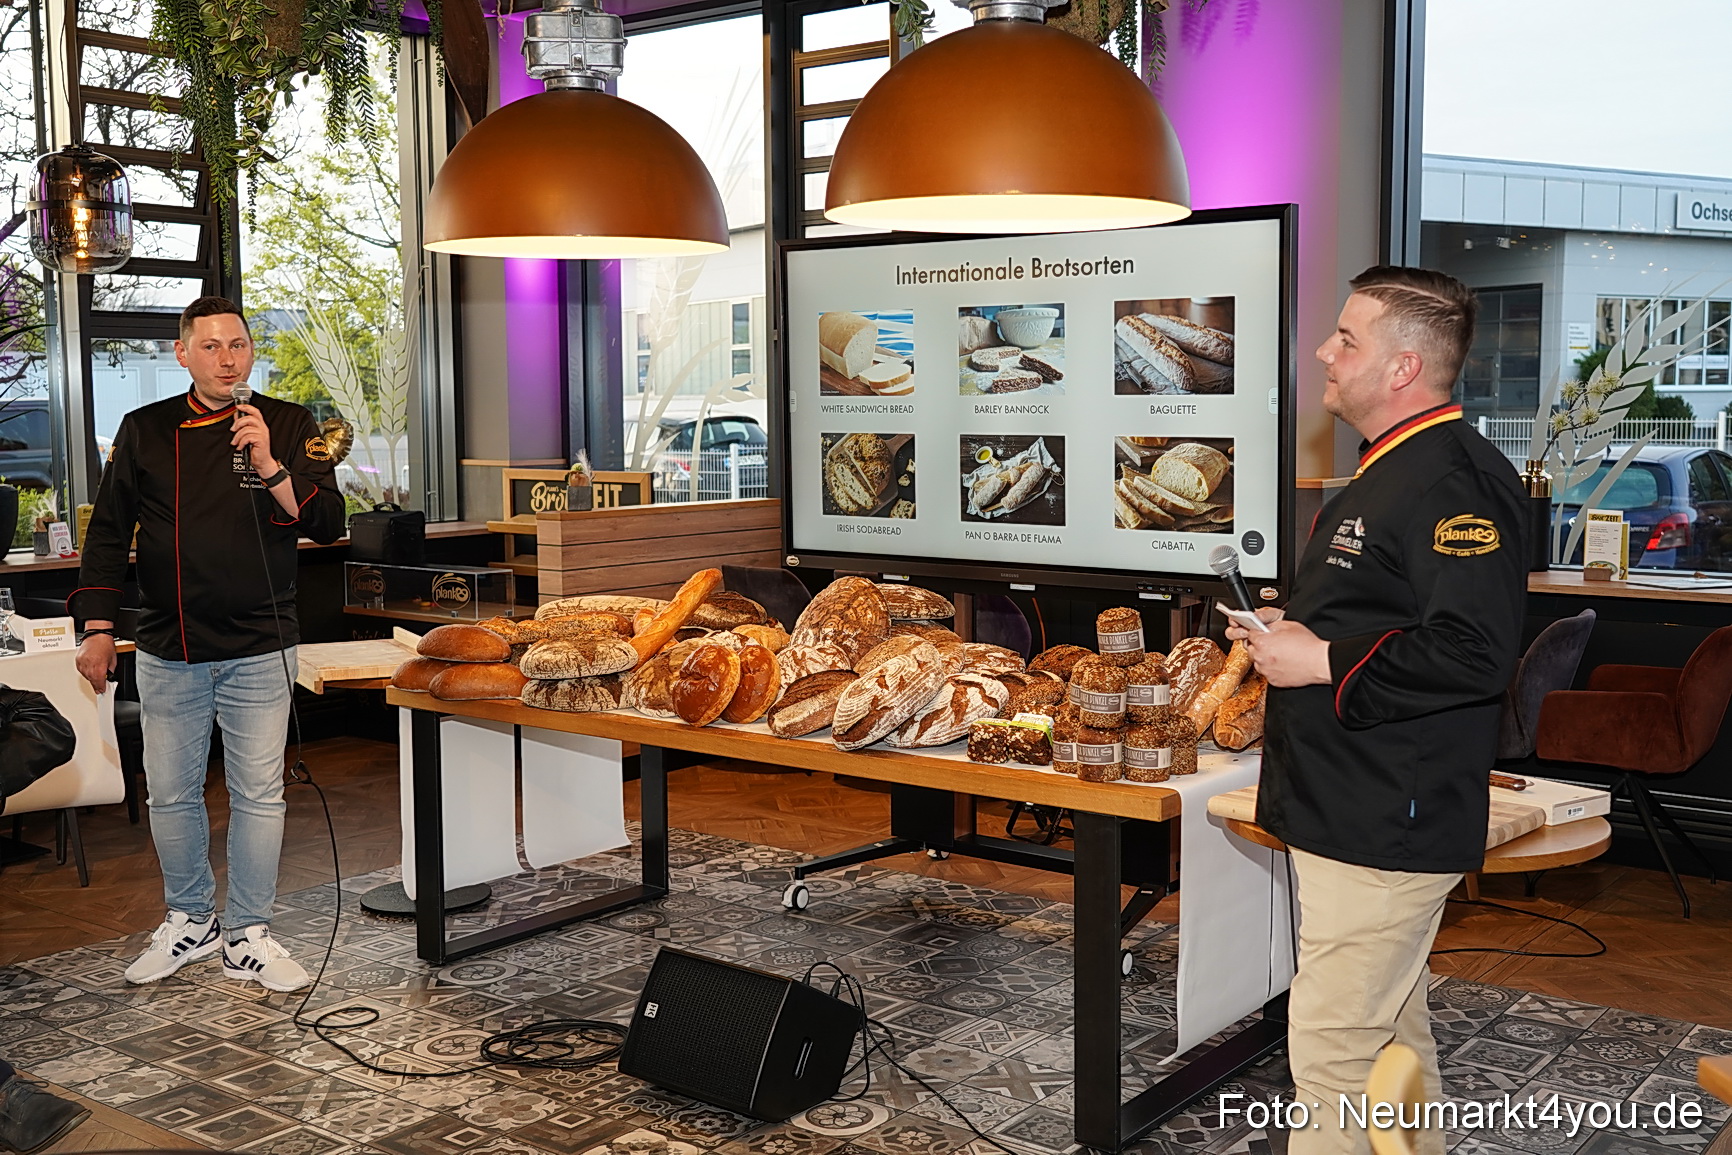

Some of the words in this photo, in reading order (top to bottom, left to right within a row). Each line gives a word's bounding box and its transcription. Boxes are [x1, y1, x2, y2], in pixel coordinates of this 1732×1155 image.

[896, 257, 1025, 285] Internationale
[1031, 256, 1134, 278] Brotsorten
[821, 405, 844, 414] WHITE
[845, 405, 889, 414] SANDWICH
[889, 405, 914, 414] BREAD
[974, 405, 1003, 414] BARLEY
[1004, 405, 1050, 414] BANNOCK
[1150, 405, 1197, 415] BAGUETTE
[836, 524, 855, 533] IRISH
[856, 525, 902, 535] SODABREAD
[965, 531, 982, 540] PAN
[983, 531, 991, 540] O
[993, 532, 1019, 542] BARRA
[1020, 533, 1032, 542] DE
[1034, 534, 1062, 544] FLAMA
[1151, 540, 1195, 551] CIABATTA
